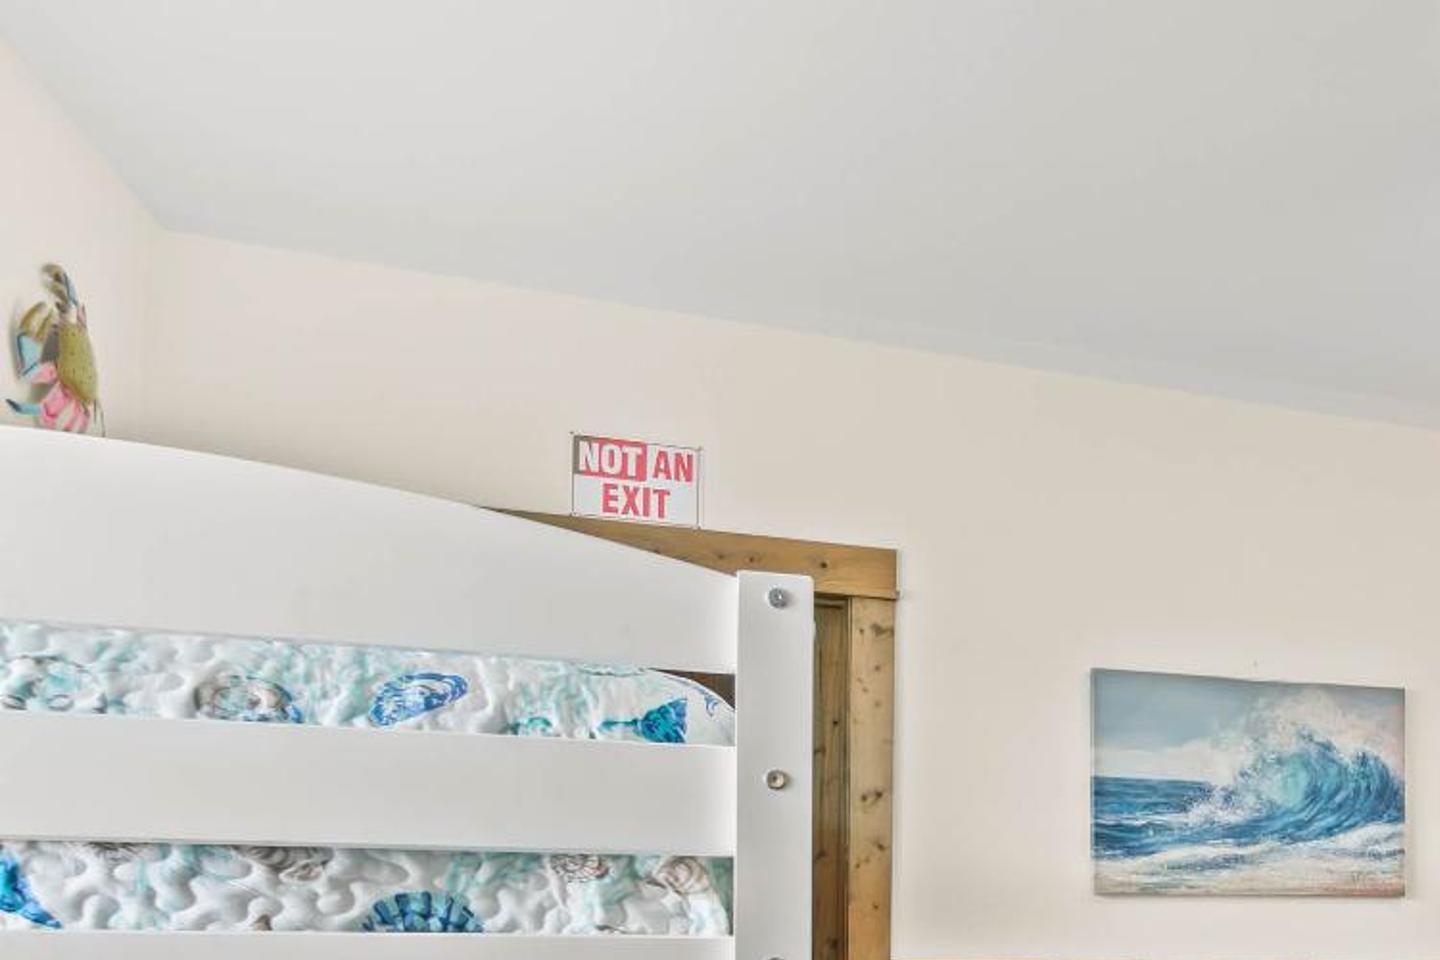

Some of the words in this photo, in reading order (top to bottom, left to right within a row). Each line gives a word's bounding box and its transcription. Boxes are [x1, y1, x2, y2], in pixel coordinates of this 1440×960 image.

[577, 441, 643, 477] NOT
[652, 451, 693, 482] AN
[602, 483, 671, 519] EXIT
